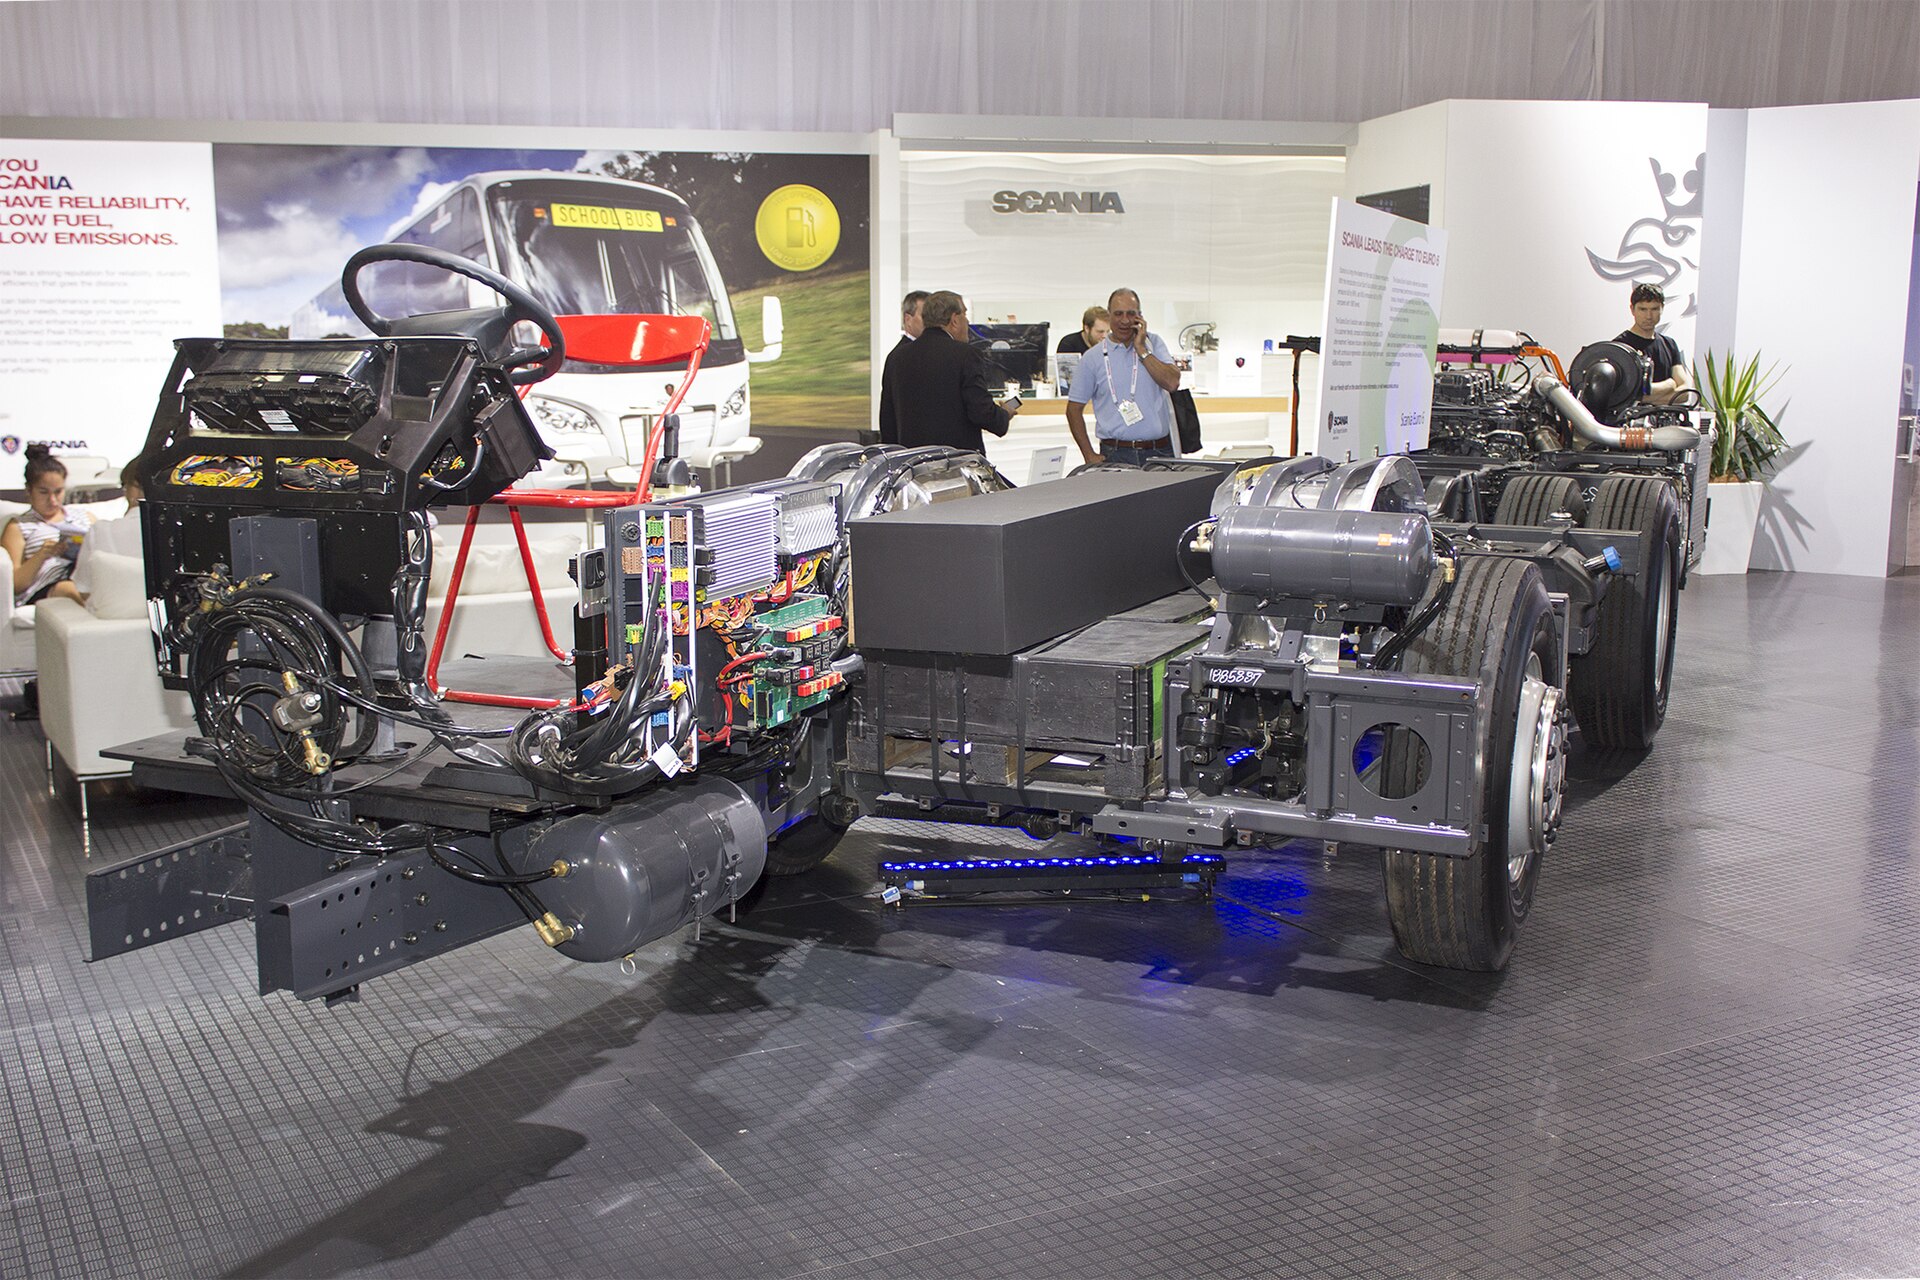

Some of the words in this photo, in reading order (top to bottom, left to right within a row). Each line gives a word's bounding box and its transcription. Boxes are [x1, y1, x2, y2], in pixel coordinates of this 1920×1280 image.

[59, 196, 190, 212] RELIABILITY,
[992, 190, 1125, 214] SCANIA
[53, 214, 114, 229] FUEL,
[560, 206, 620, 226] SCHOOL
[625, 211, 654, 228] BUS
[0, 231, 48, 245] LOW
[55, 232, 179, 246] EMISSIONS.
[1341, 231, 1364, 249] SCANIA
[1364, 237, 1382, 254] LEADS
[1382, 241, 1393, 257] THE
[1393, 244, 1415, 261] CHARGE
[1415, 249, 1422, 263] TO
[1422, 251, 1436, 266] EURO
